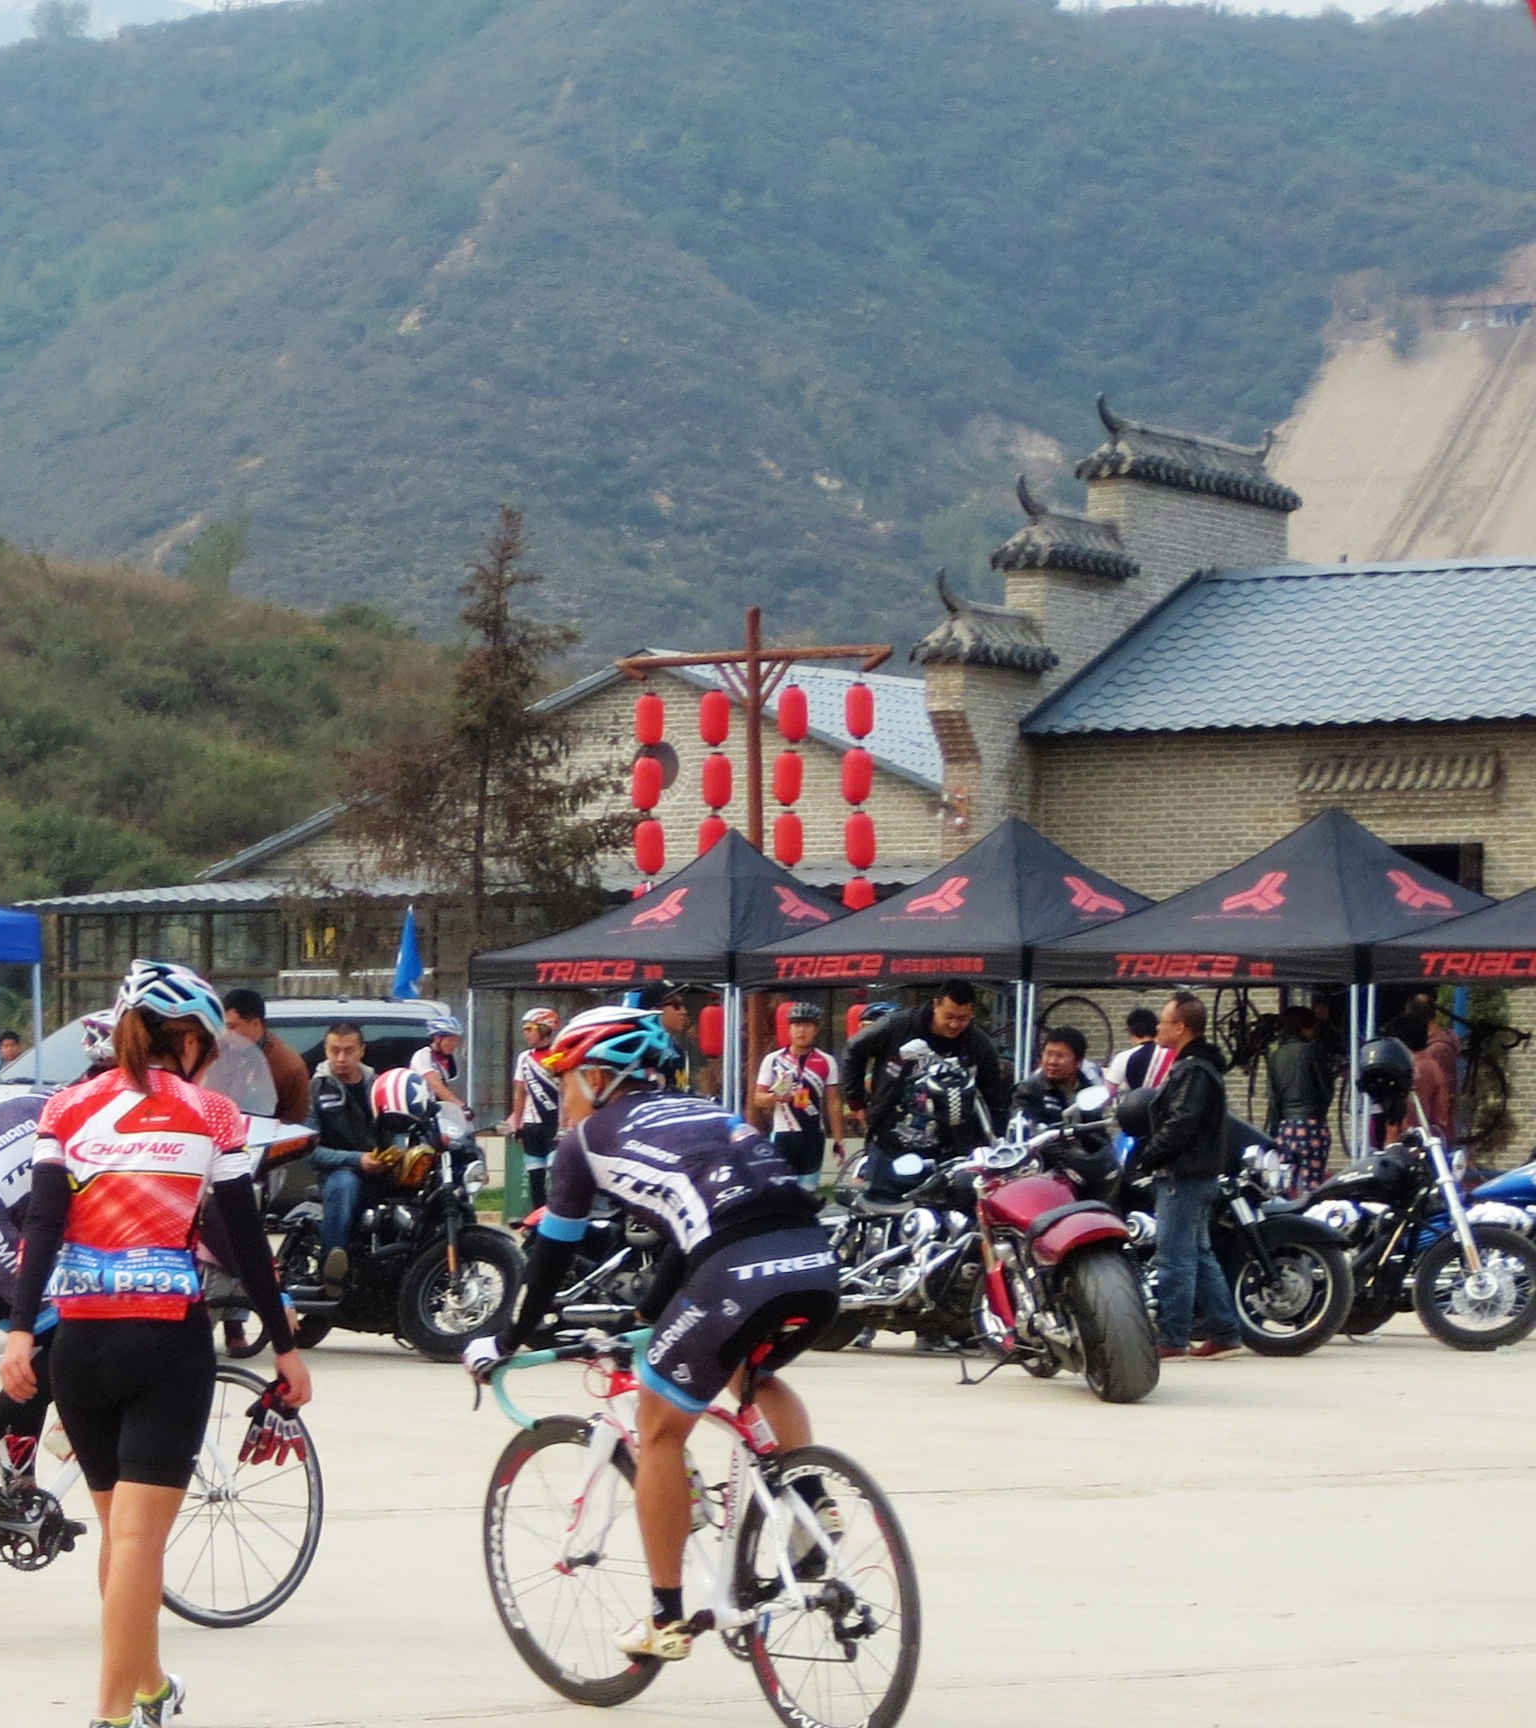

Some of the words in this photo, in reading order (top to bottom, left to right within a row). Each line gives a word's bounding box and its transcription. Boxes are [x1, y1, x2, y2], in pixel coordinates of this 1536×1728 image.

[91, 1138, 186, 1157] CHAOYANG
[728, 1250, 839, 1281] TREK
[647, 1303, 708, 1367] GARMIN
